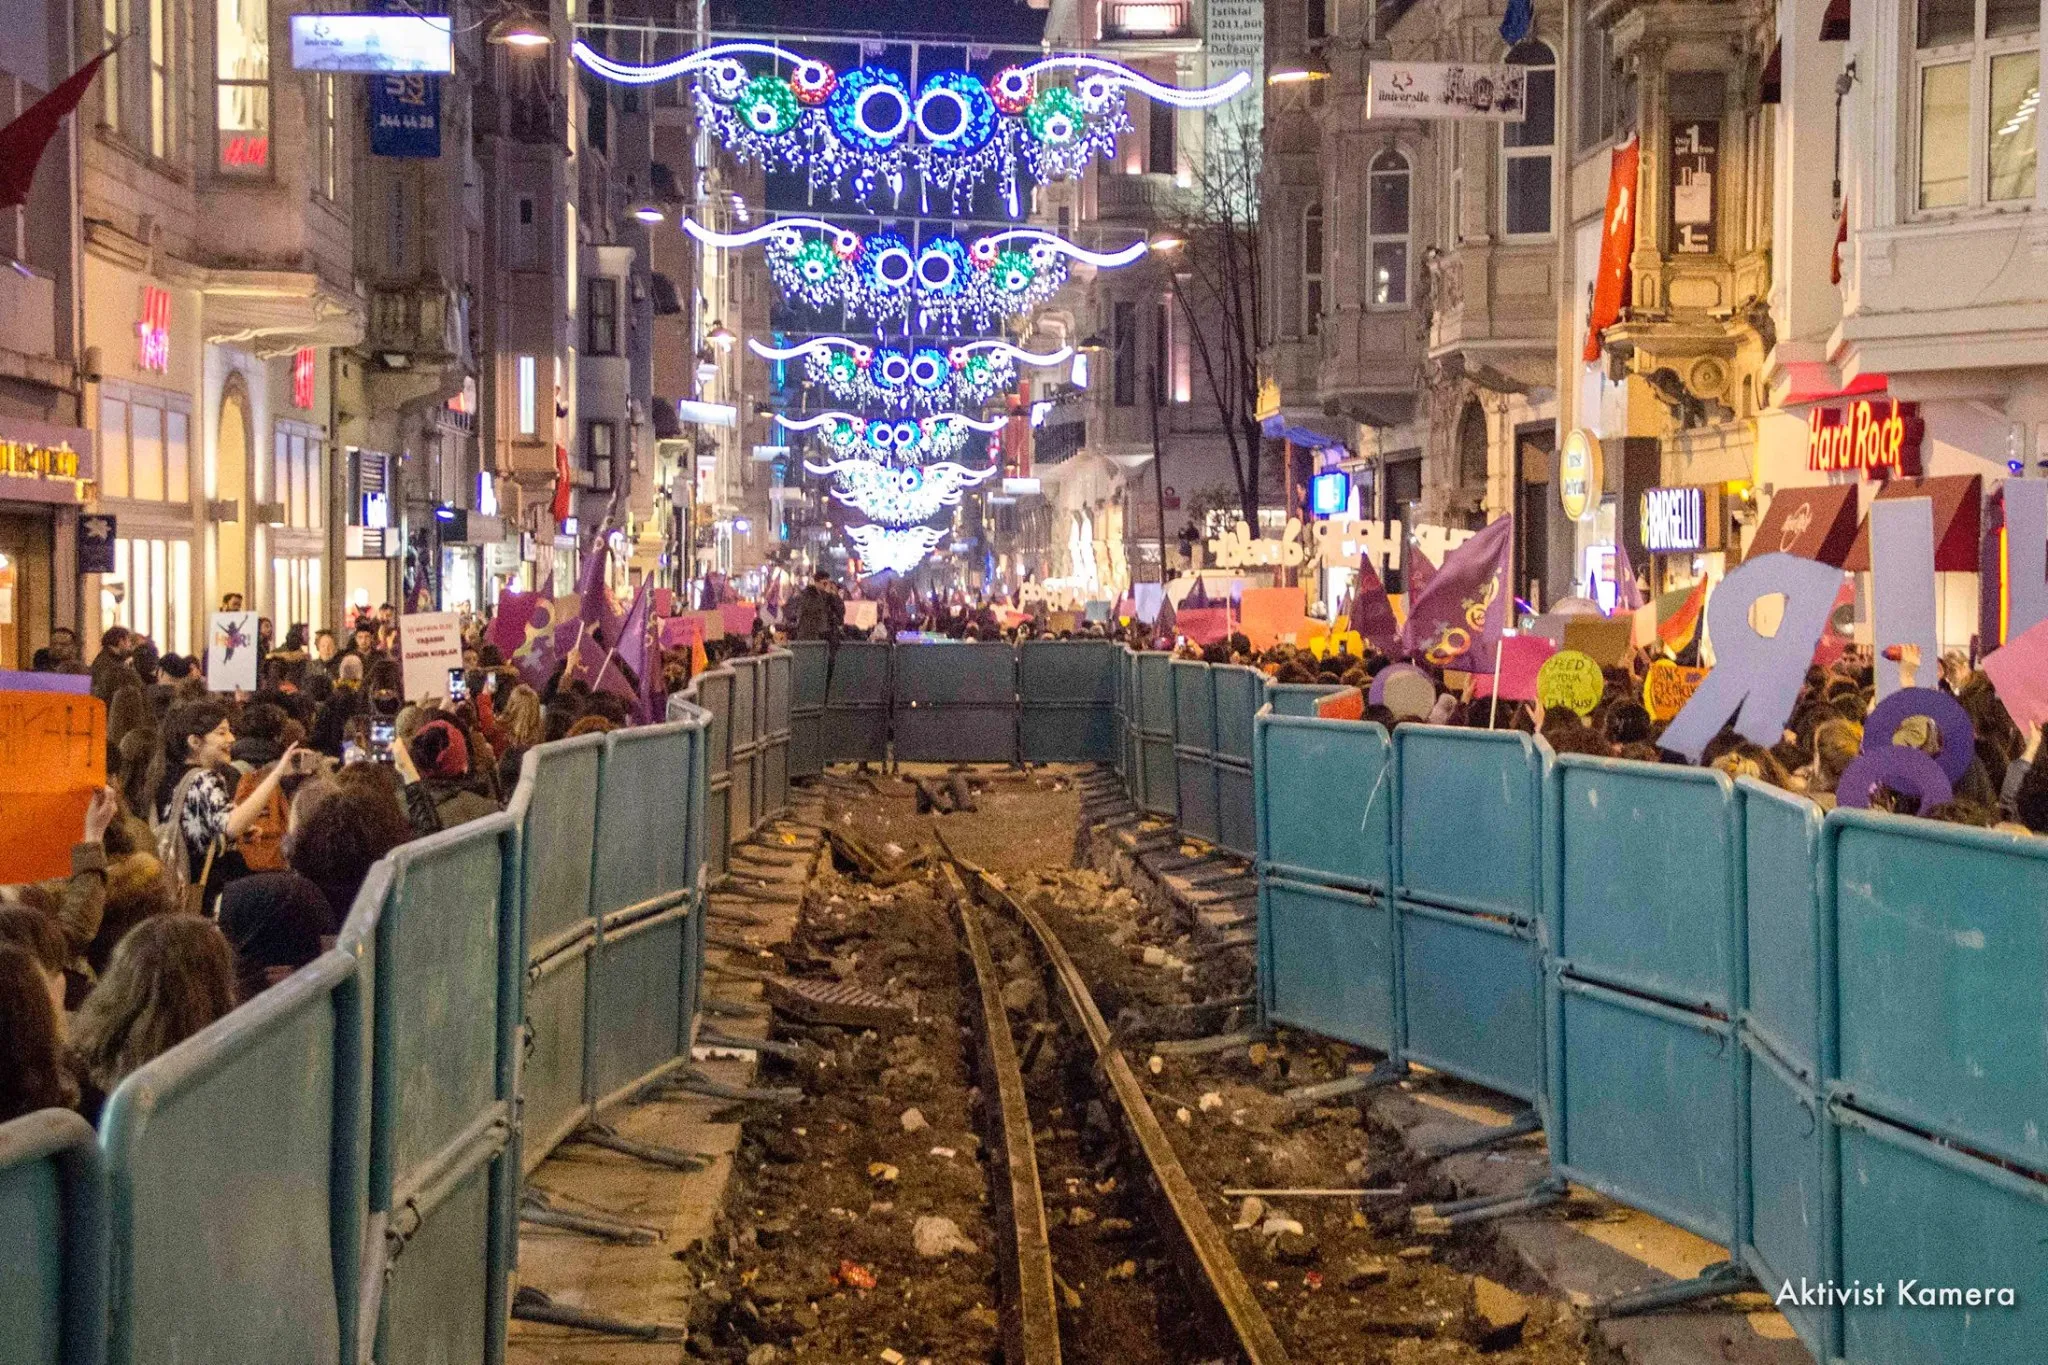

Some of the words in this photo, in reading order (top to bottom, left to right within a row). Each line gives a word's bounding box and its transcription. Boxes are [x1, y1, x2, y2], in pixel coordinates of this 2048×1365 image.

[1808, 401, 1855, 472] Hard
[1854, 397, 1904, 482] Rock
[1649, 487, 1701, 549] BARGELLO
